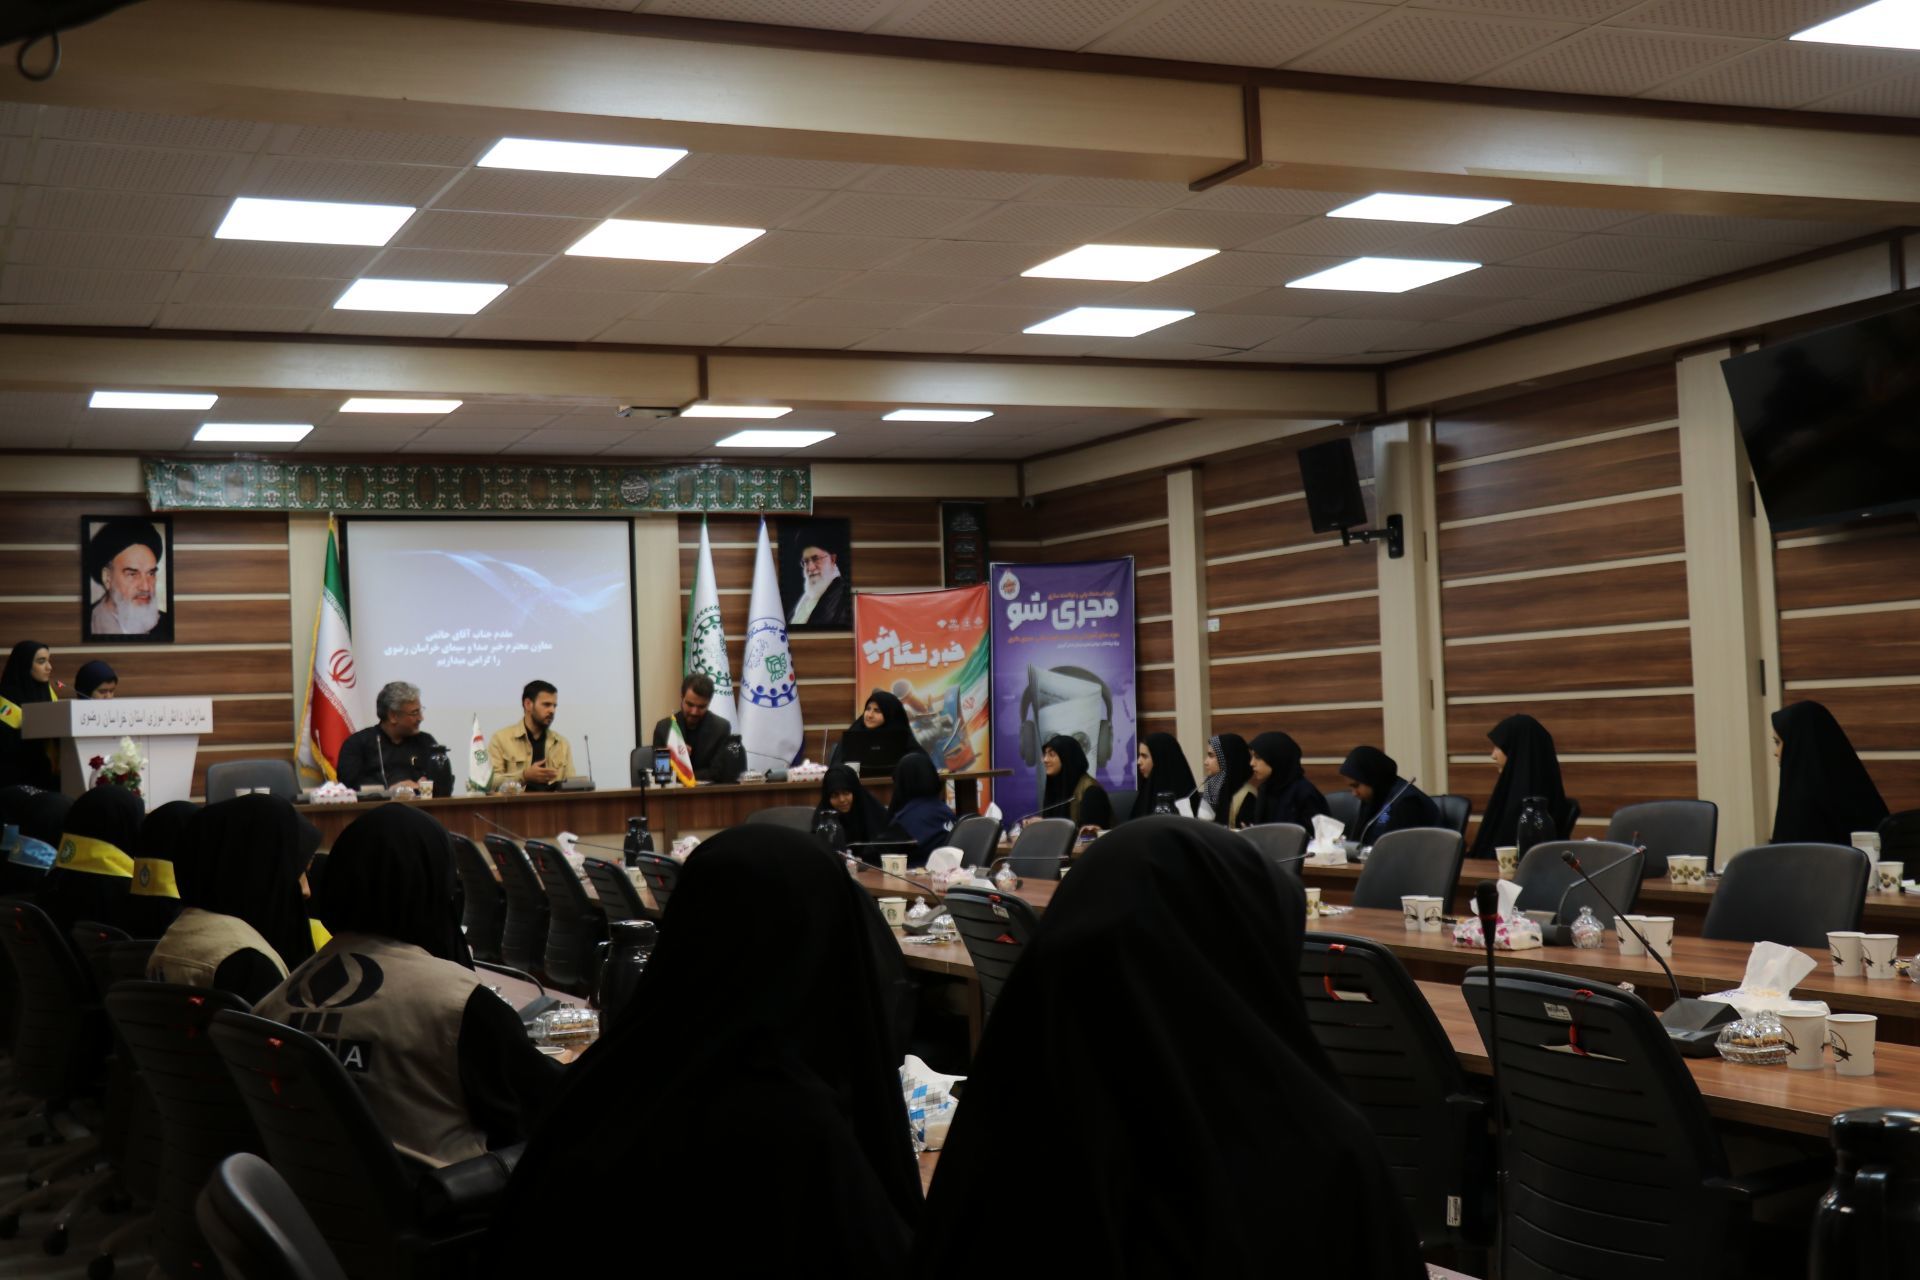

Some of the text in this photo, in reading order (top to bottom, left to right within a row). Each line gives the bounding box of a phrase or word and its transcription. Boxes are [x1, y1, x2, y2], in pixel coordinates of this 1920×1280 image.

[1007, 592, 1119, 631] مجری شو
[452, 628, 471, 641] آقای
[472, 629, 492, 640] جناب
[494, 631, 513, 640] مقدم
[384, 645, 409, 656] رضوی
[411, 643, 440, 655] خراسان
[473, 642, 490, 651] صدا
[505, 642, 529, 653] محترم
[531, 641, 553, 653] معاون
[493, 655, 501, 667] را
[80, 709, 102, 726] رضوی
[104, 707, 128, 728] خراسان
